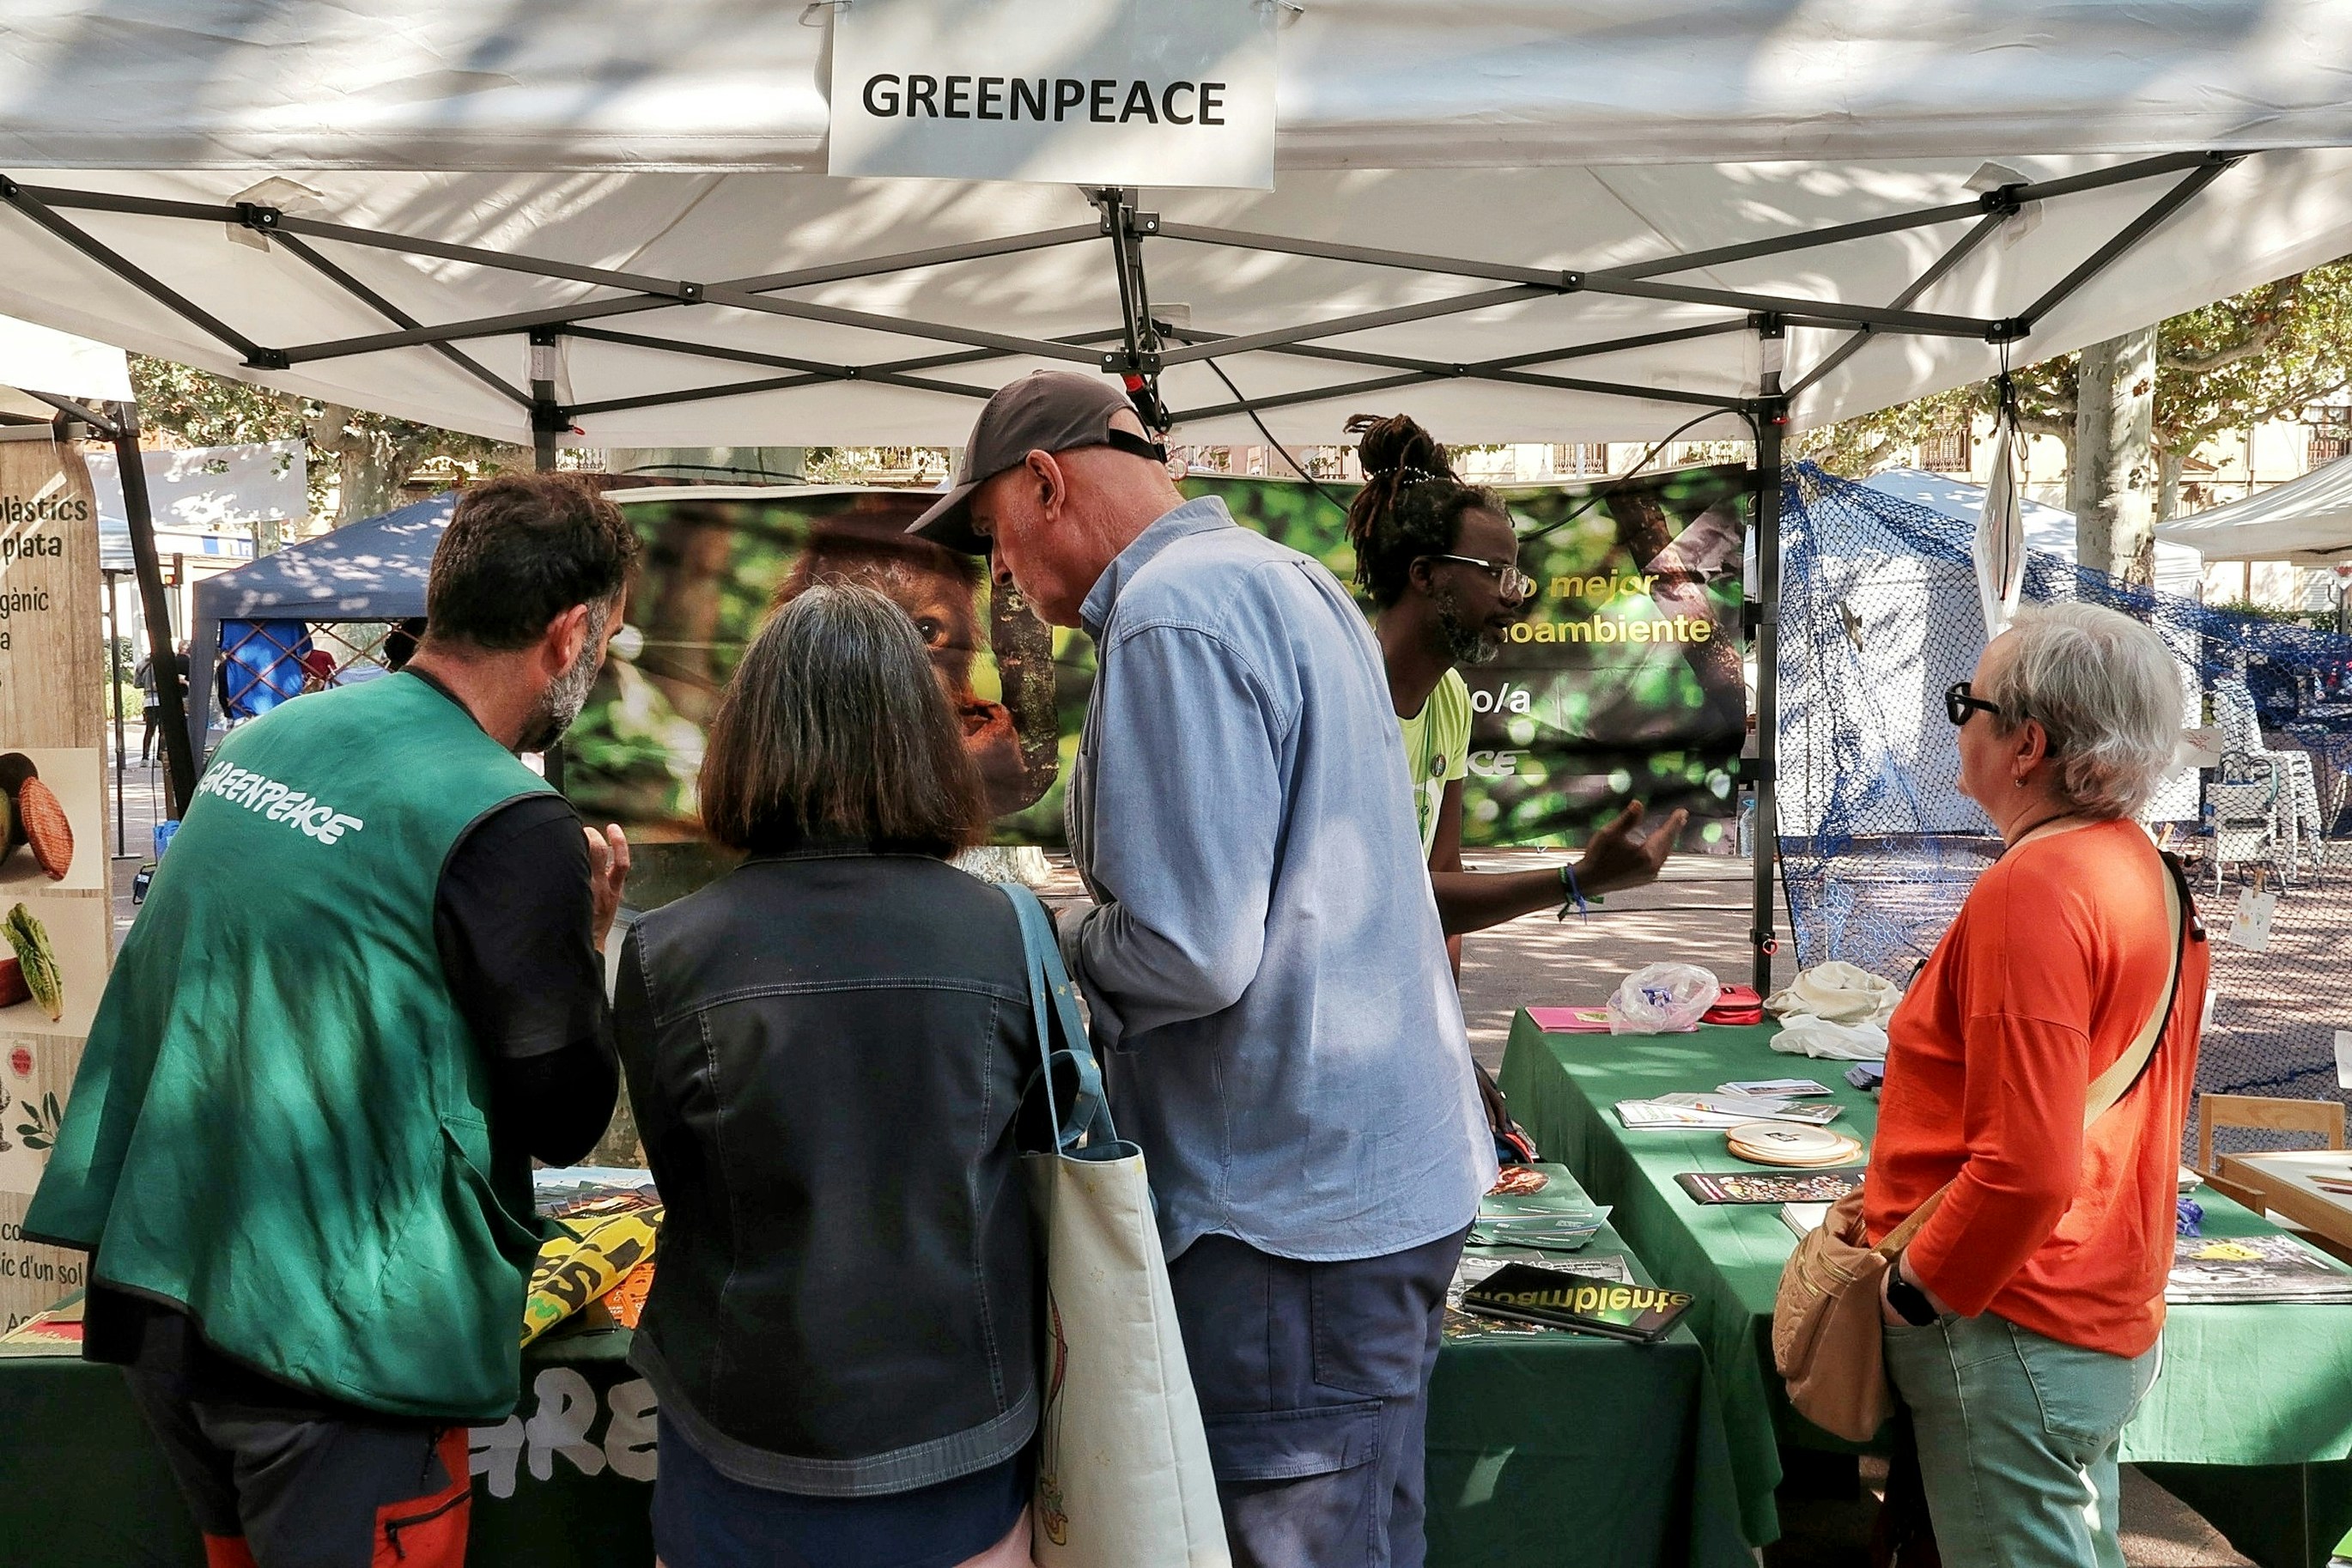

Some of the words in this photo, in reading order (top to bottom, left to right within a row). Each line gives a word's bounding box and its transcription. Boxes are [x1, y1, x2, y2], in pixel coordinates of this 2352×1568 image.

[862, 74, 1226, 125] GREENPEACE
[0, 494, 88, 524] làstics
[3, 532, 62, 565] plata
[1550, 568, 1658, 604] mejor
[1465, 683, 1531, 713] o/a
[1464, 750, 1530, 776] CE
[200, 761, 363, 845] GREENPEACE
[0, 1252, 15, 1277] ic
[20, 1255, 54, 1281] d'un
[58, 1262, 83, 1286] sol
